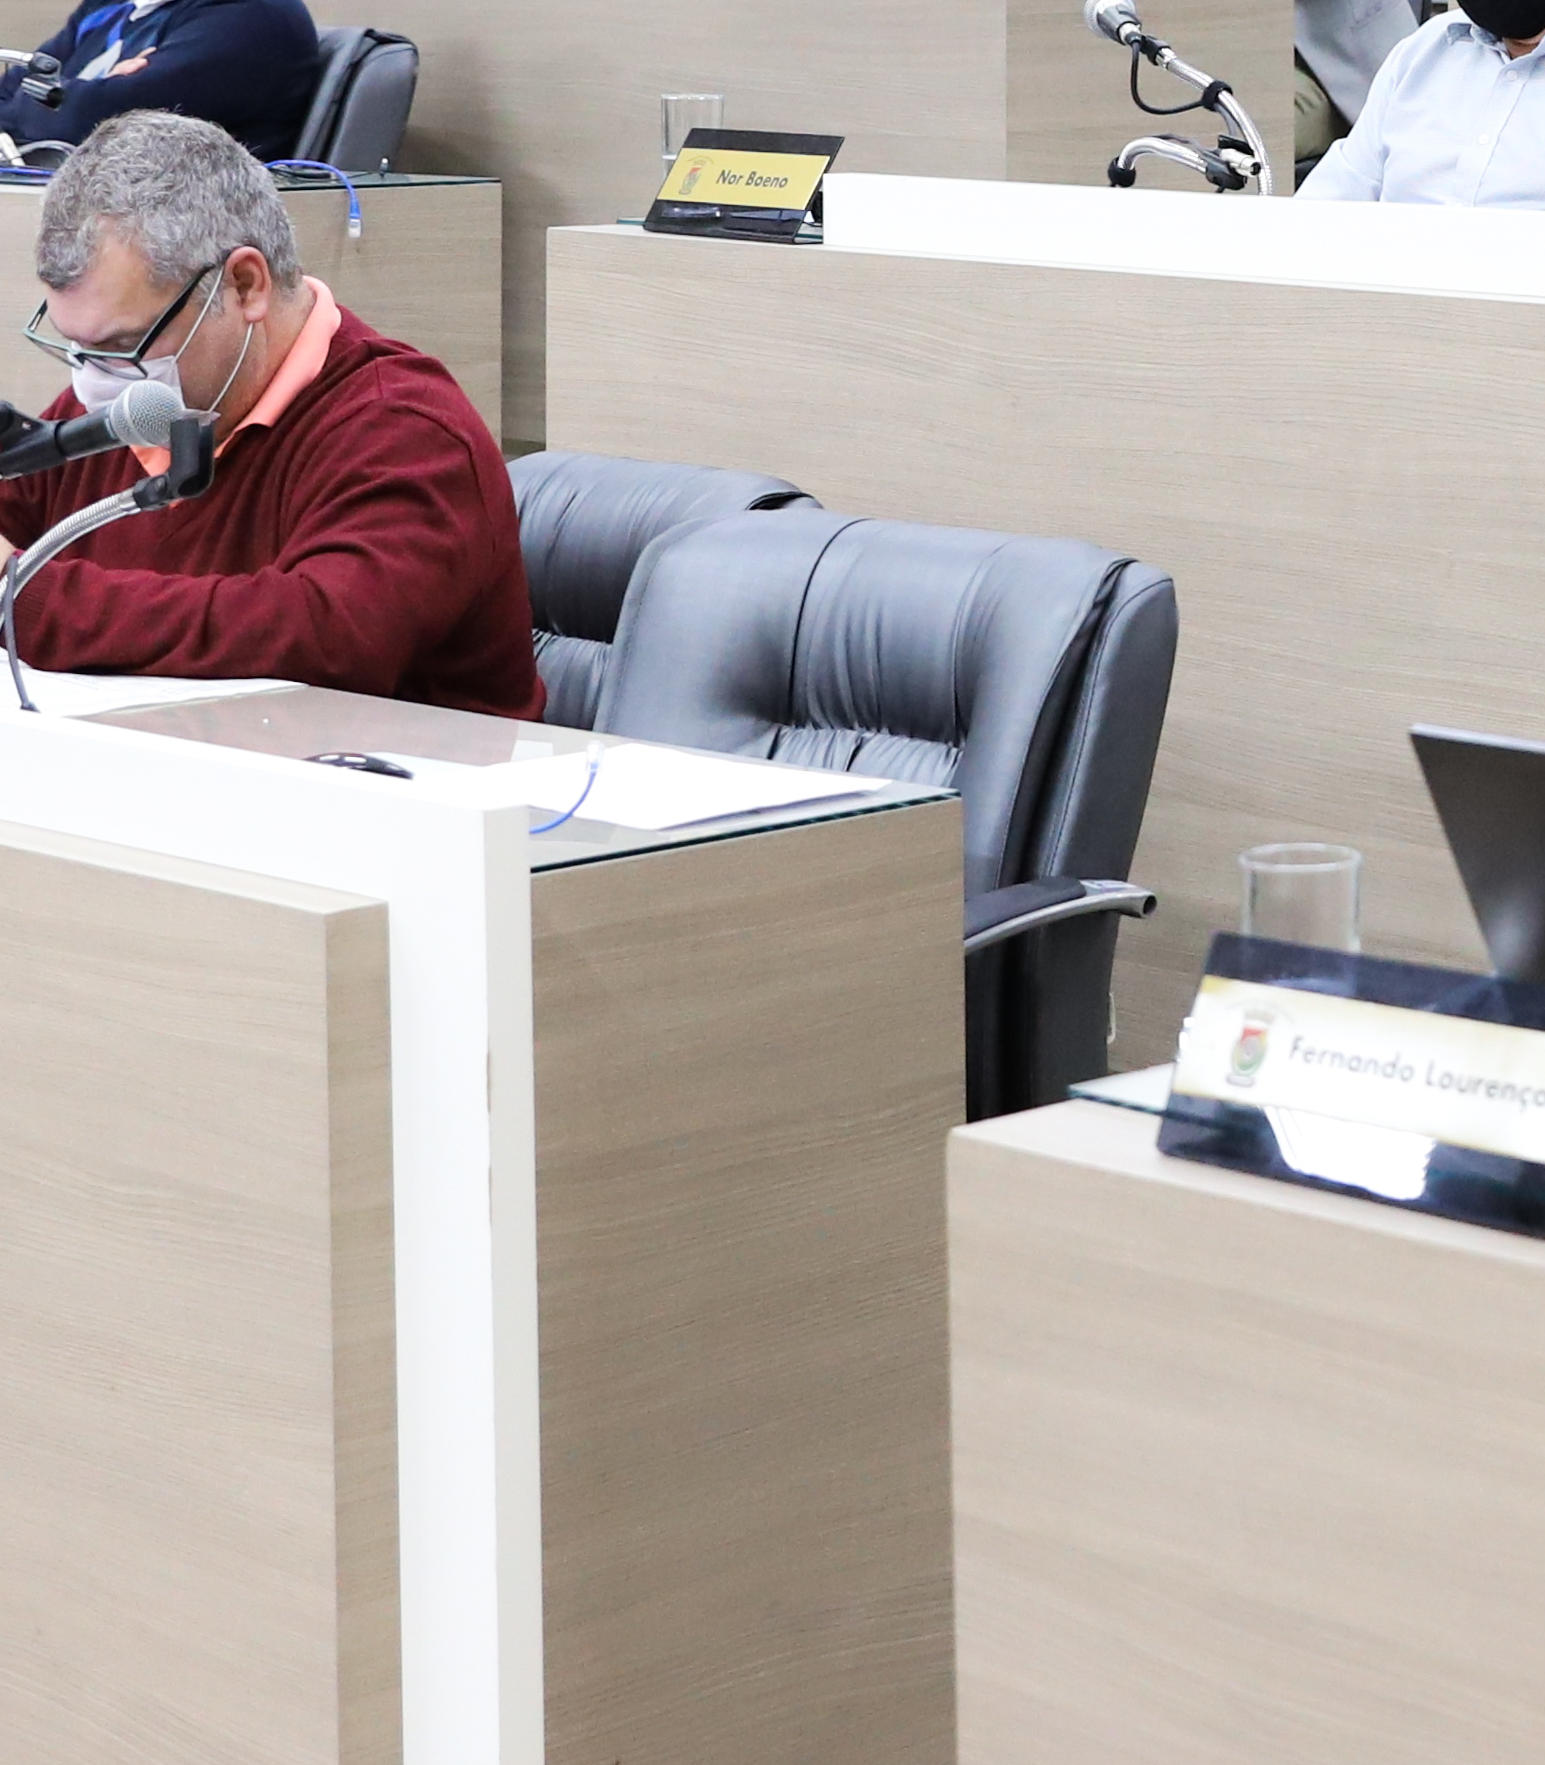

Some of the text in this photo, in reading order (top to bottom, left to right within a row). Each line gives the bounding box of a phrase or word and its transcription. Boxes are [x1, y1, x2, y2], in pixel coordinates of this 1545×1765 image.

[715, 169, 788, 188] Nor Boeno
[1289, 1035, 1414, 1083] Fernando
